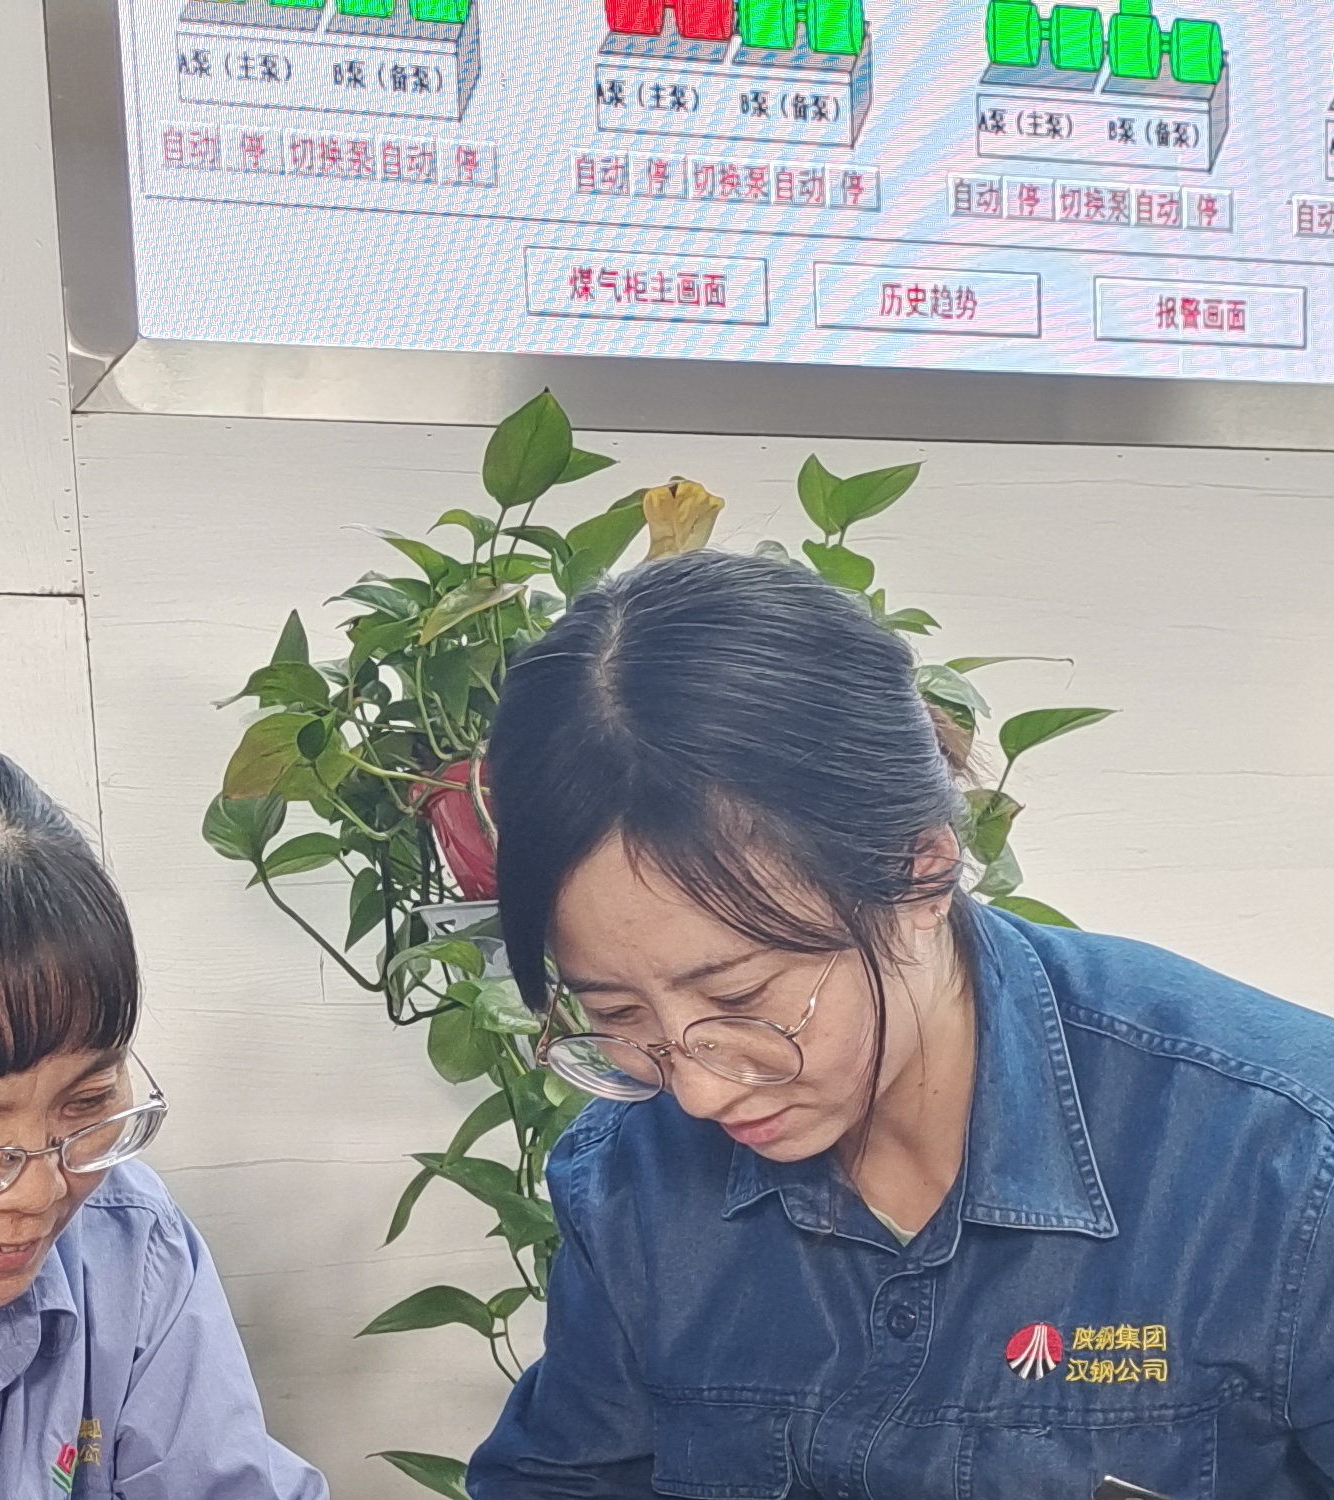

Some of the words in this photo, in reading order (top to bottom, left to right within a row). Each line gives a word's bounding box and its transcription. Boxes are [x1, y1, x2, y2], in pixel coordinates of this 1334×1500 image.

[569, 266, 727, 309] 煤气柜主画面
[878, 281, 979, 321] 历史趋势
[1155, 294, 1248, 333] 报警画面
[1072, 1323, 1166, 1352] 陕钢集团
[1065, 1357, 1168, 1384] 汉钢公司
